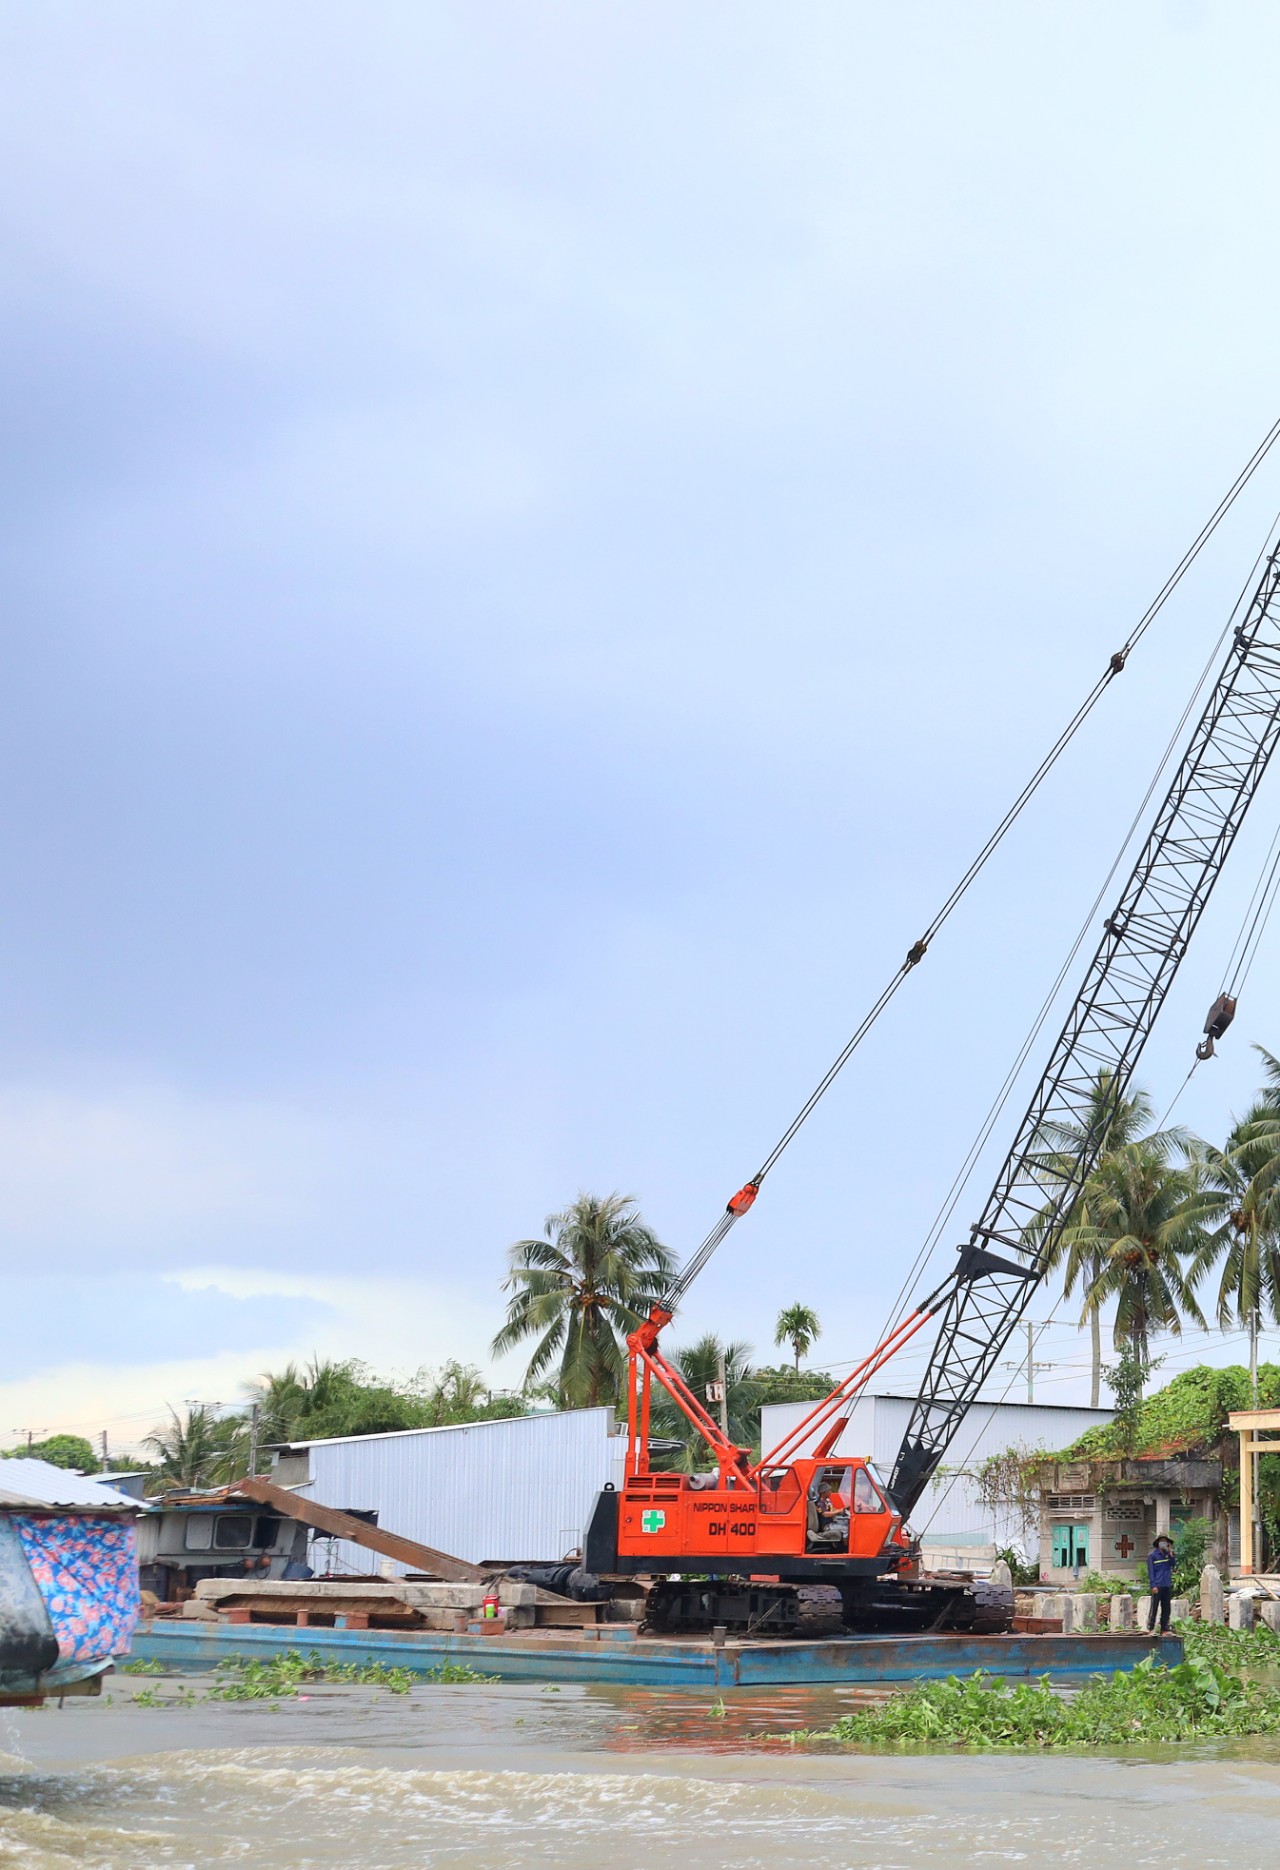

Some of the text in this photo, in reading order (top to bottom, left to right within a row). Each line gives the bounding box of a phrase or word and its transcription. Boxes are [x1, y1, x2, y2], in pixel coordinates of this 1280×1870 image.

[693, 1503, 767, 1513] NIPPON SHARO
[709, 1523, 756, 1536] DH 400
